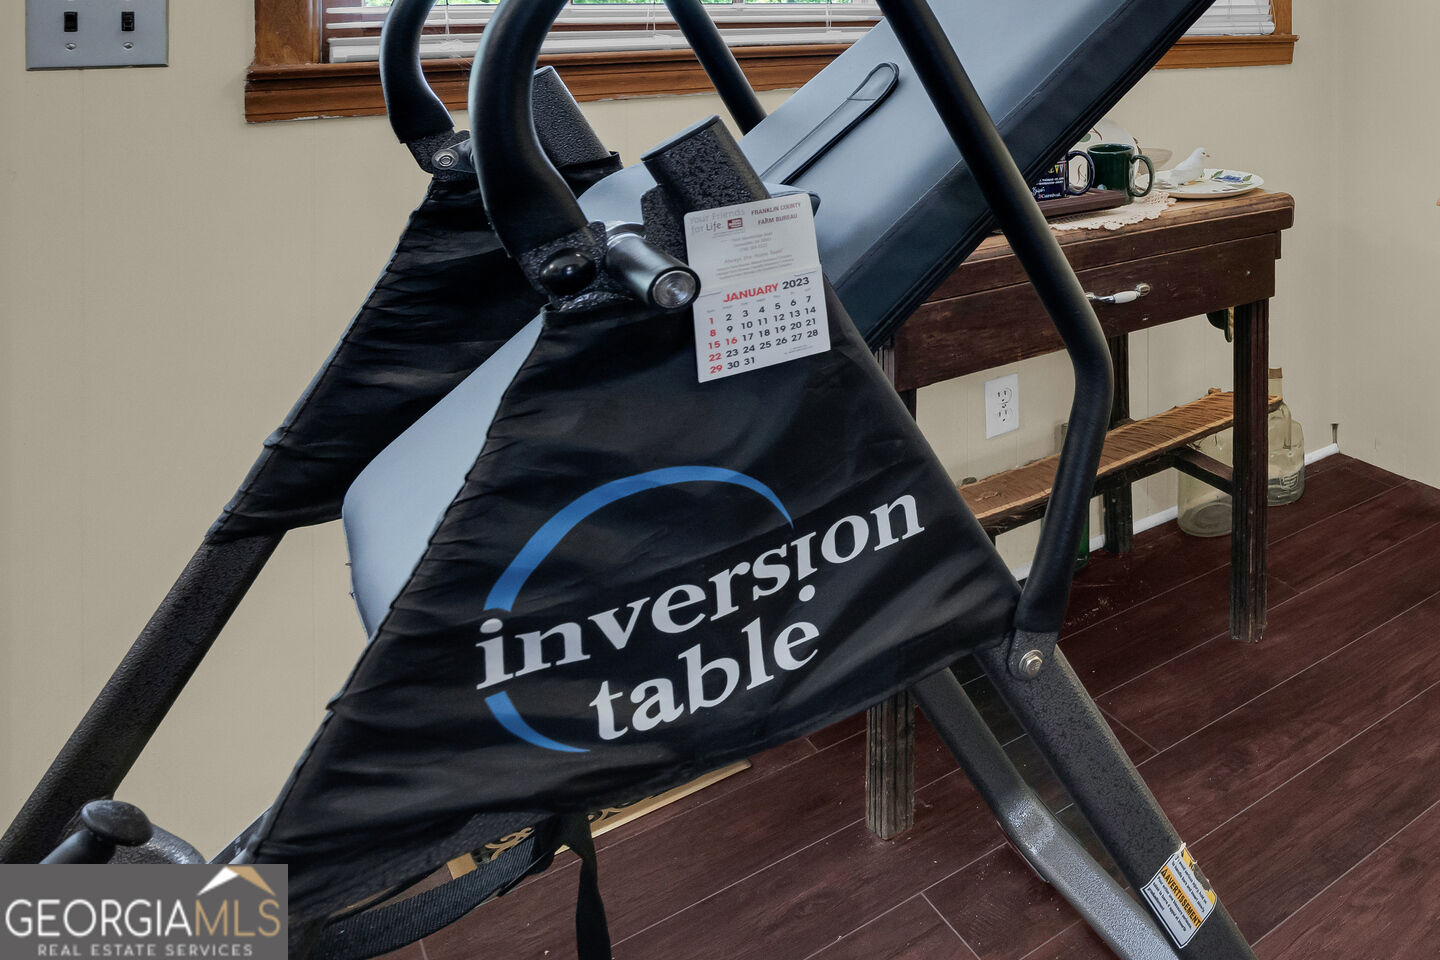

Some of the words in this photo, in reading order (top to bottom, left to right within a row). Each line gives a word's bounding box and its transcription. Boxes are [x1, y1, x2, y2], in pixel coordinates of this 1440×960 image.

[751, 206, 779, 215] FRANKLIN
[780, 202, 801, 211] COUNTY
[776, 213, 798, 223] BUREAU
[723, 283, 778, 302] JANUARY
[782, 277, 809, 290] 2023
[709, 341, 720, 349] 15
[726, 337, 738, 345] 16
[743, 333, 753, 341] 17
[790, 322, 801, 330] 20
[709, 353, 722, 362] 22
[726, 349, 738, 358] 23
[743, 345, 755, 353] 24
[760, 341, 771, 350] 25
[776, 337, 787, 346] 26
[792, 333, 802, 342] 27
[807, 330, 818, 338] 28
[710, 365, 722, 374] 29
[727, 361, 739, 369] 30
[744, 357, 754, 365] 31
[475, 493, 925, 691] inversion
[589, 617, 820, 741] table
[1164, 873, 1201, 926] AVERTISSEMENT
